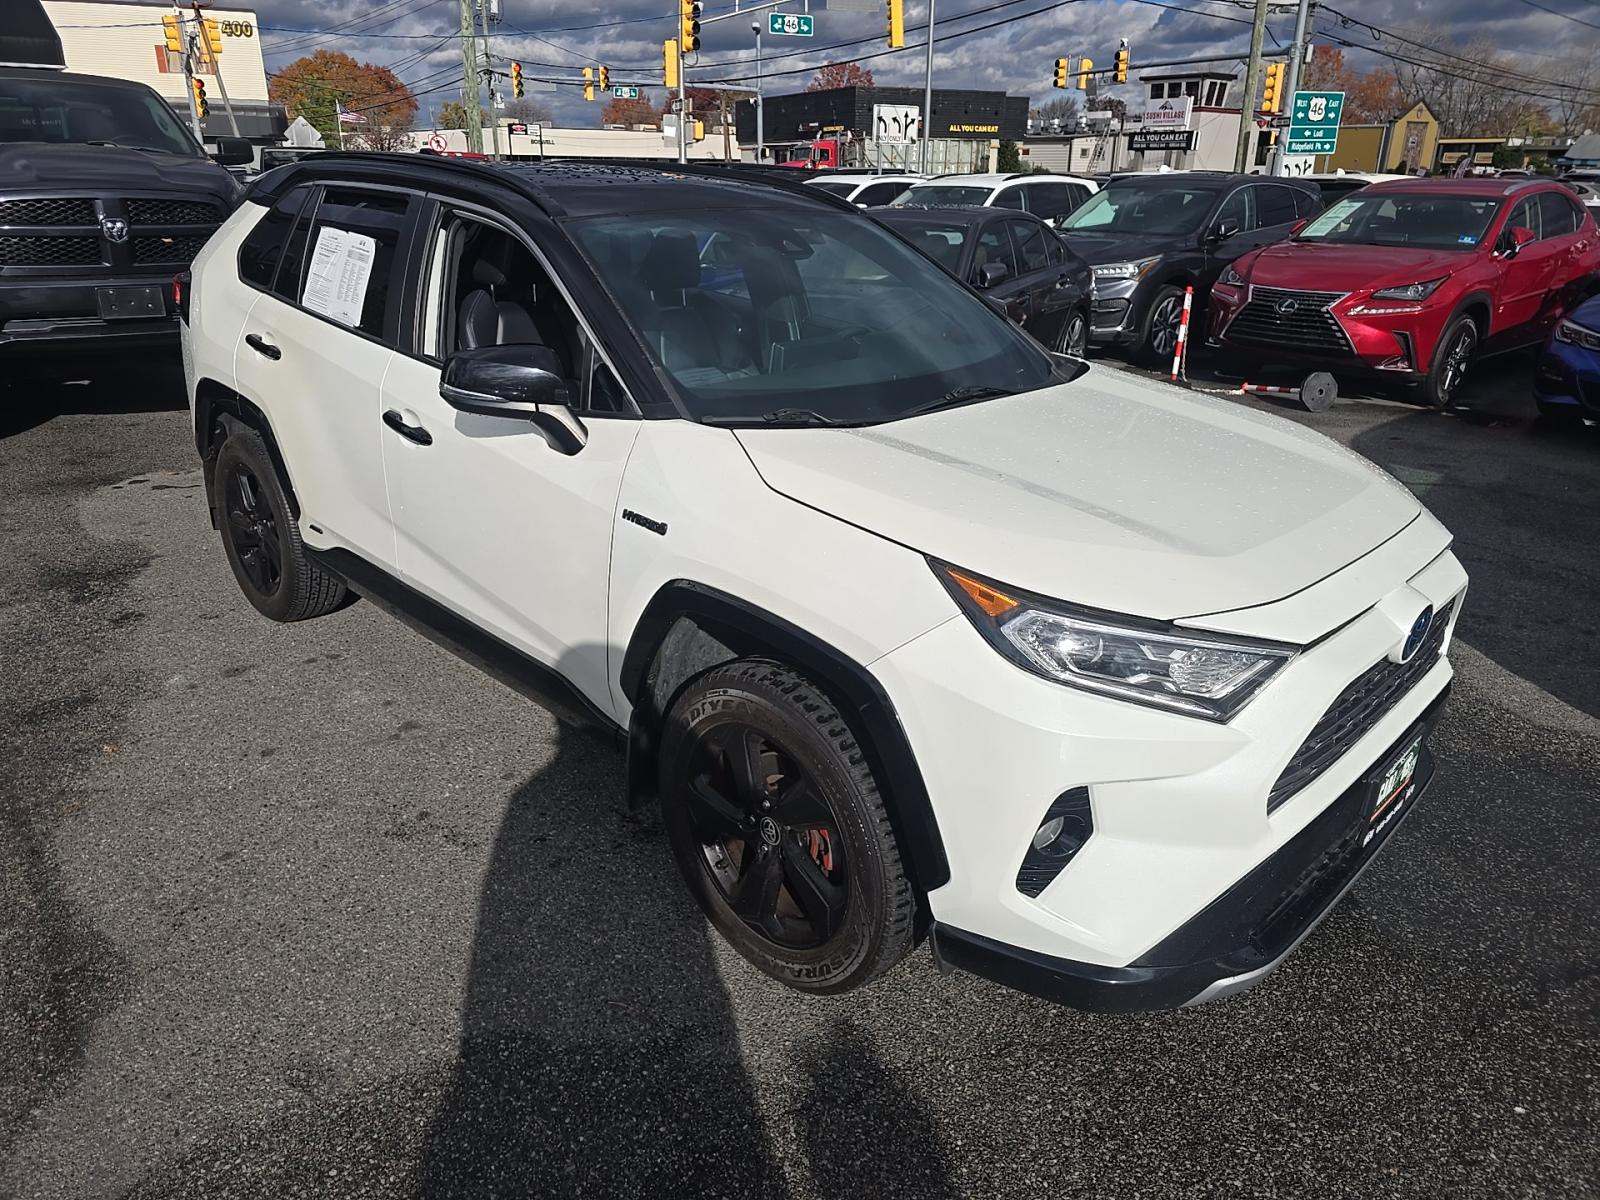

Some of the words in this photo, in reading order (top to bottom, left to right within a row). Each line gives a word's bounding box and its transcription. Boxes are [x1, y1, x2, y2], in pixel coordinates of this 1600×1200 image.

[221, 20, 253, 37] 400
[785, 19, 797, 29] 46
[1311, 103, 1324, 116] 46
[1145, 111, 1161, 120] SUSHI
[1162, 110, 1185, 119] VILLAGE
[949, 124, 961, 132] ALL
[962, 124, 974, 132] YOU
